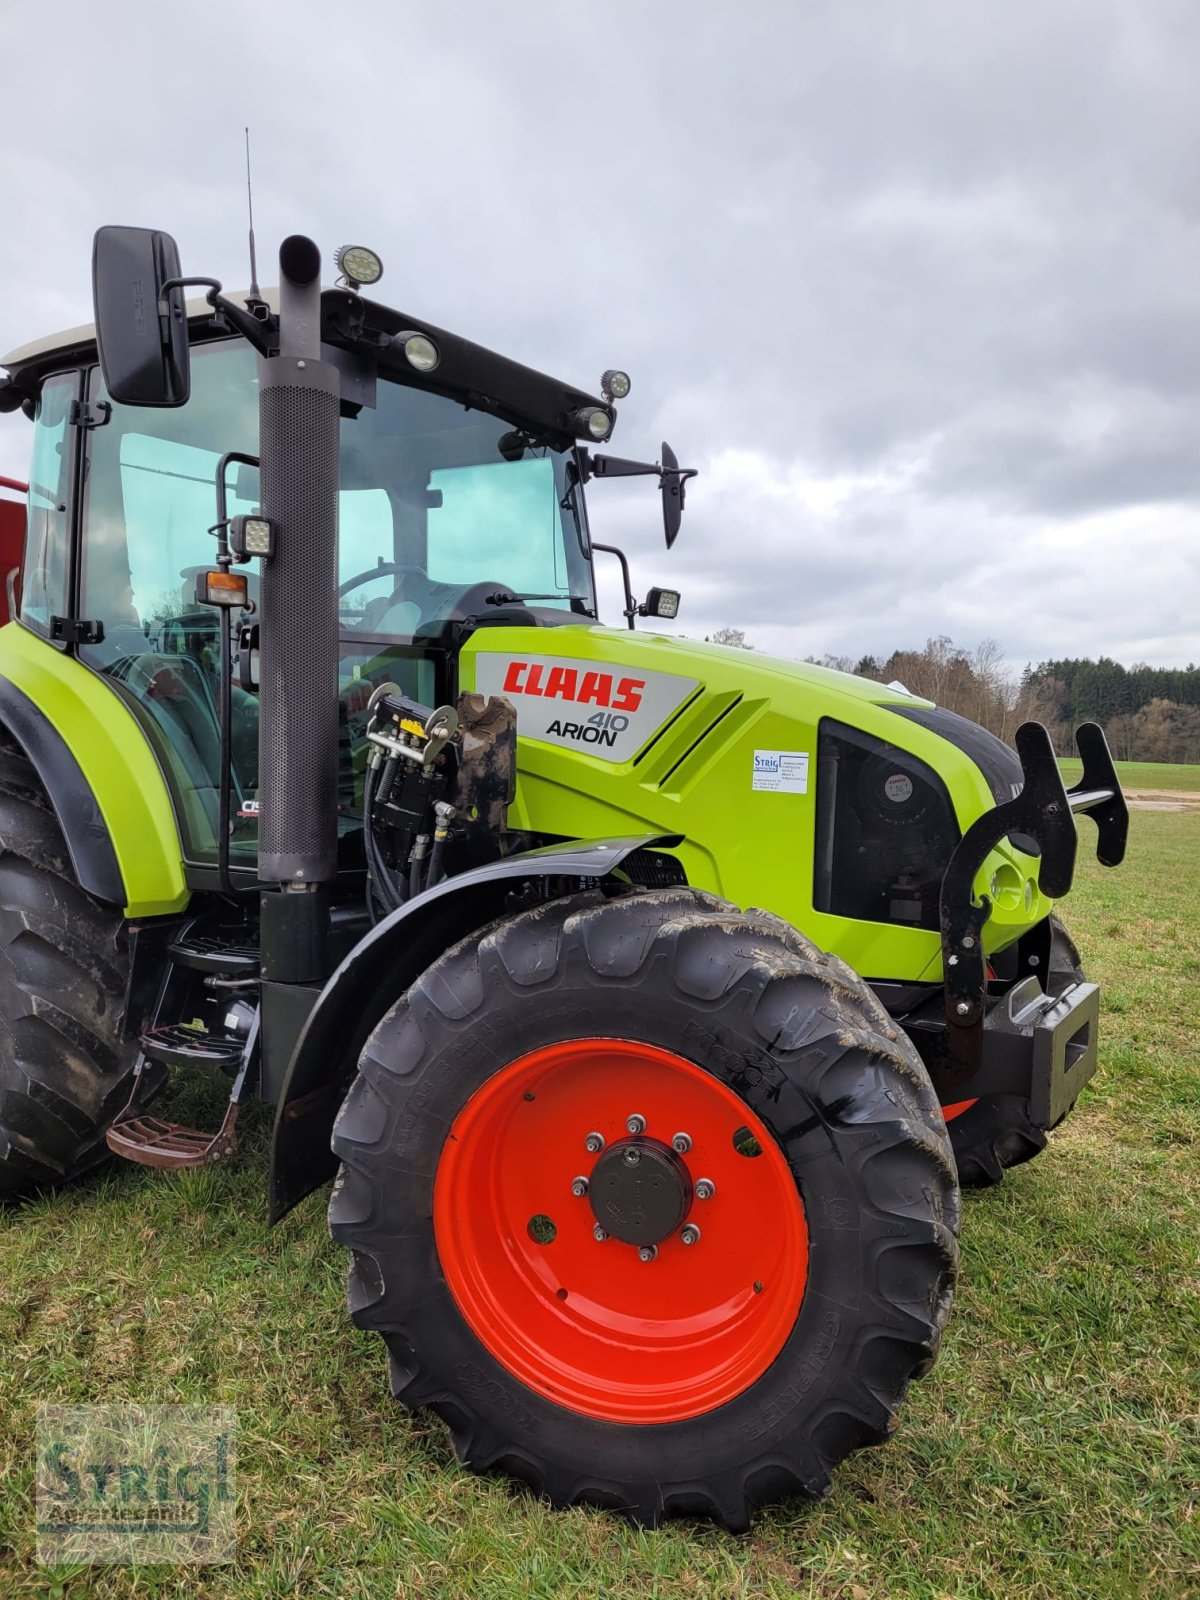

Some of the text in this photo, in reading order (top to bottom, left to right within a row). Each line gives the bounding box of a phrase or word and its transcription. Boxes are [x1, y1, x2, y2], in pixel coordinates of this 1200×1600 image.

[503, 661, 646, 712] CLAAS
[545, 719, 618, 747] ARION
[587, 711, 630, 732] 410
[741, 1311, 840, 1441] GRIPKER
